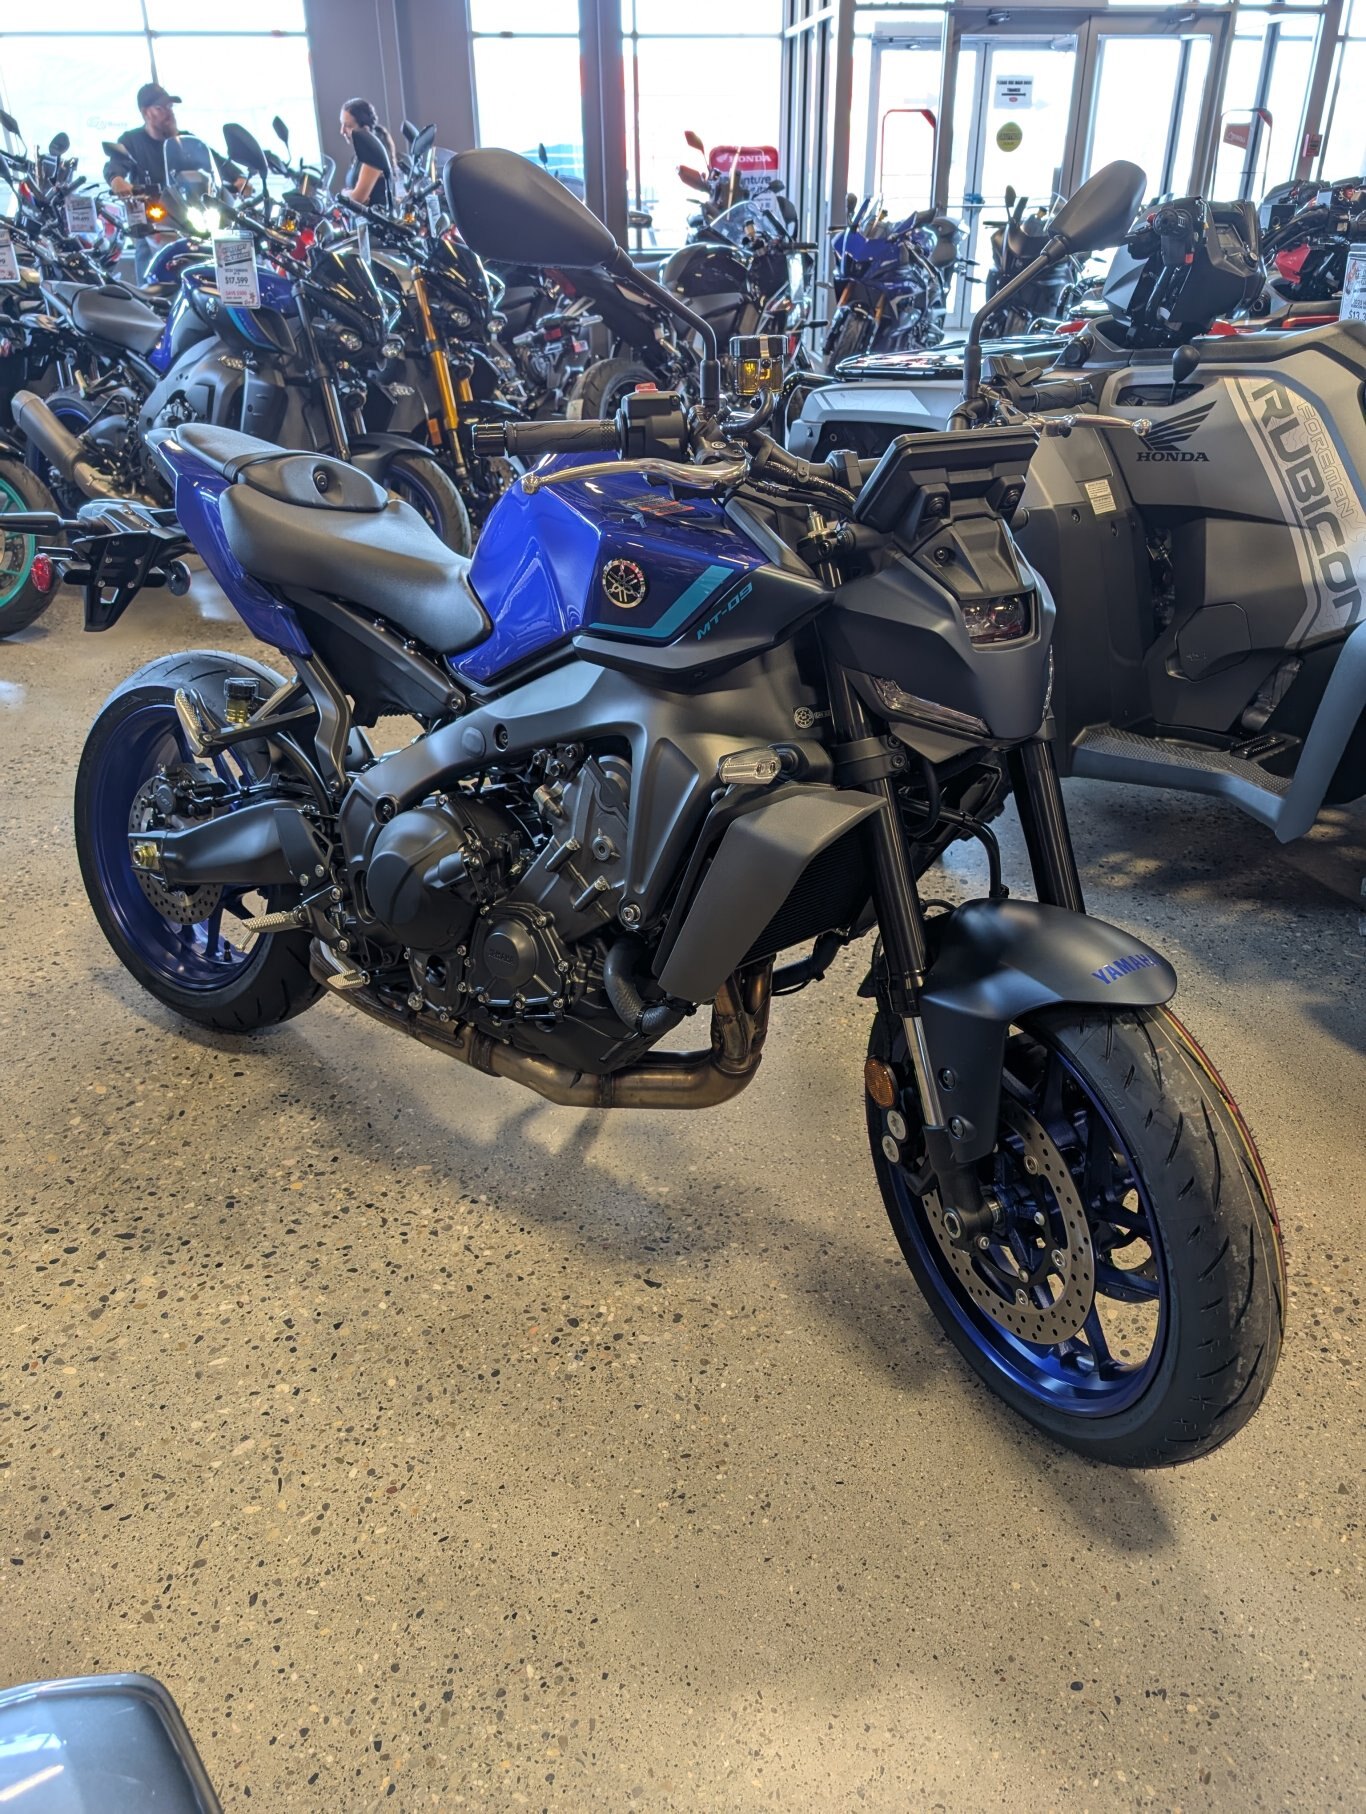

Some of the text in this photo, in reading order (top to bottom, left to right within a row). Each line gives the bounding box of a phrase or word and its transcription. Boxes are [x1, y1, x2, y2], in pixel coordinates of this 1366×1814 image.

[1136, 452, 1210, 462] HONDA
[1297, 403, 1354, 518] FOREMAN
[1252, 381, 1362, 630] RUBICON
[696, 581, 753, 641] MT-09
